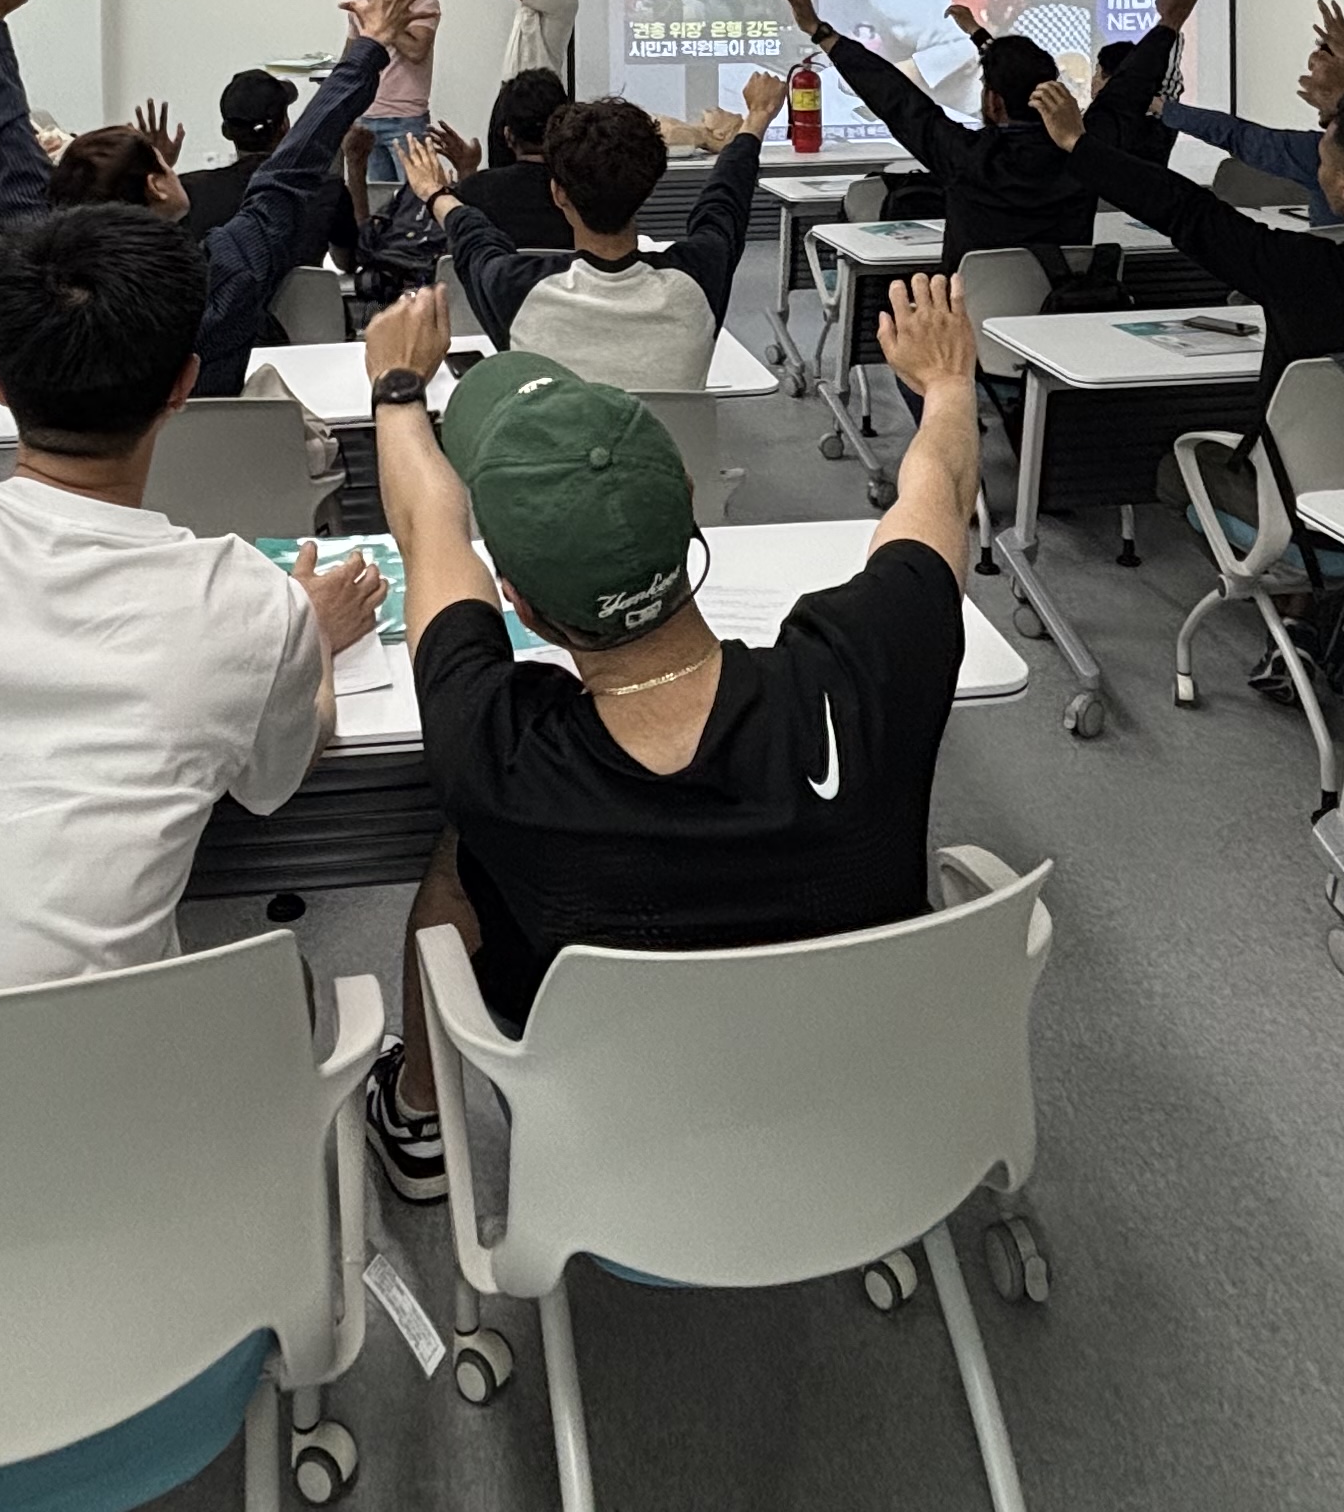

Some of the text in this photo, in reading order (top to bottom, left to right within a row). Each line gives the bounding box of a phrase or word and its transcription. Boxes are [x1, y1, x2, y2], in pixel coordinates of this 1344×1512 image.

[710, 20, 742, 38] 은행
[628, 38, 781, 57] 시민과 직원들이 제압
